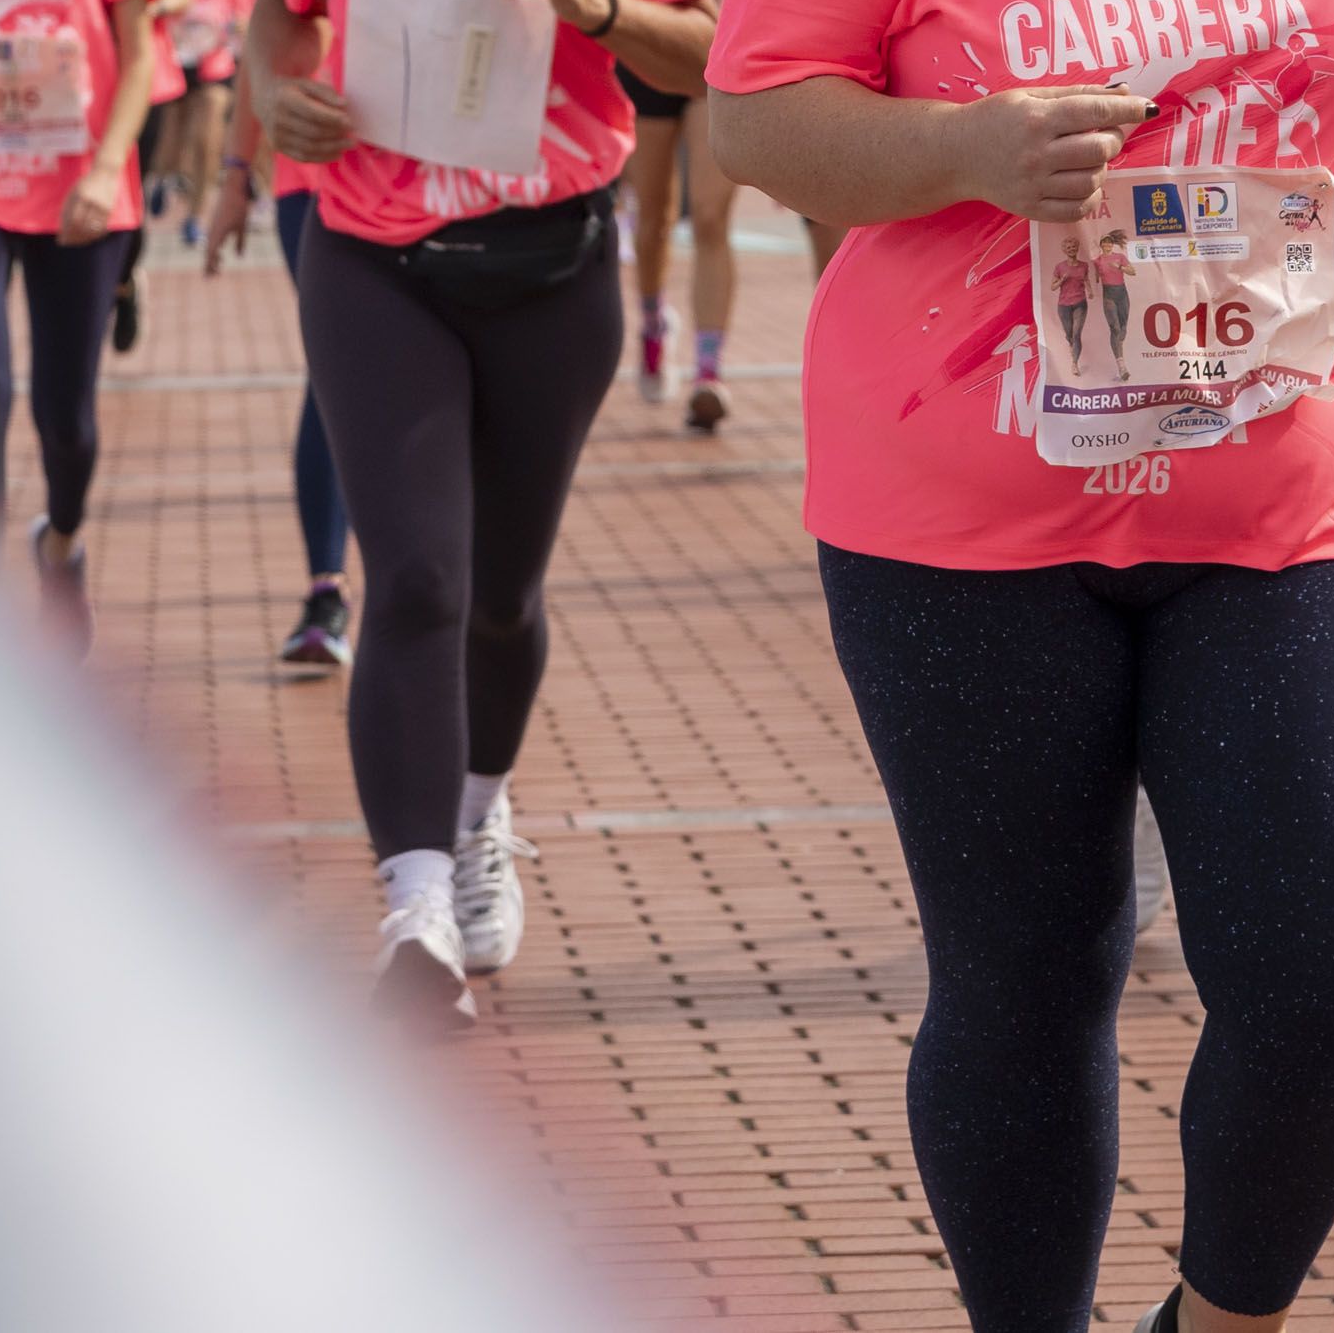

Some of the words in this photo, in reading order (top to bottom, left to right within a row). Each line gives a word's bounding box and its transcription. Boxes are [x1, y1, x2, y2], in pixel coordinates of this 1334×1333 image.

[1140, 224, 1156, 232] Gran
[1157, 223, 1182, 231] Canaria
[1142, 218, 1168, 226] Cabildo
[1143, 301, 1254, 348] 016
[1179, 360, 1227, 380] 2144
[1051, 392, 1122, 410] CARRERA
[1127, 392, 1146, 407] DE
[1150, 389, 1167, 404] LA
[1172, 388, 1223, 405] MUJER
[1164, 418, 1224, 429] ASTURIANA
[1071, 432, 1130, 448] OYSHO
[1083, 455, 1172, 495] 2026
